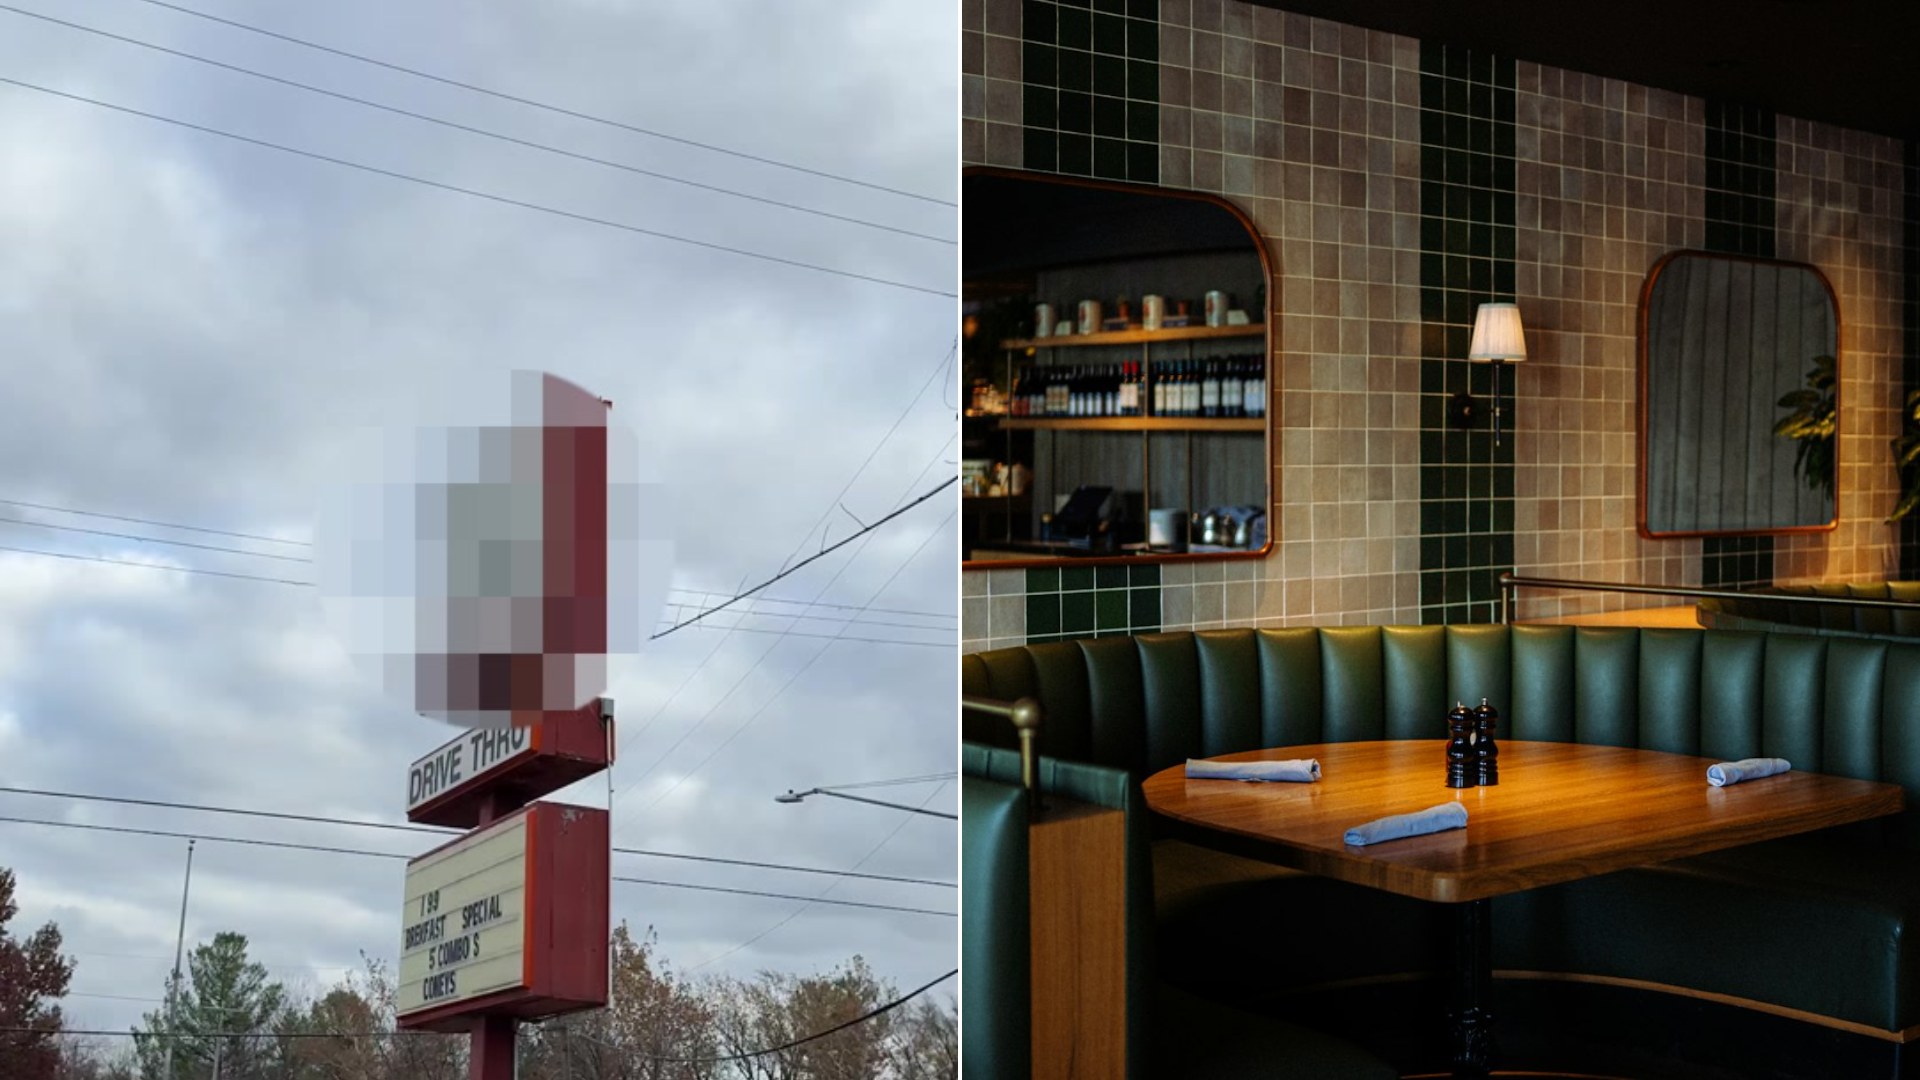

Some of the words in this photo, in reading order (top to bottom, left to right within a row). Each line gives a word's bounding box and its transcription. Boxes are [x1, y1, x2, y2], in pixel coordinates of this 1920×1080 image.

[409, 743, 463, 805] DRIVE
[462, 894, 503, 929] SPECIAL
[429, 947, 436, 970] 5
[423, 970, 456, 1001] CONEYS
